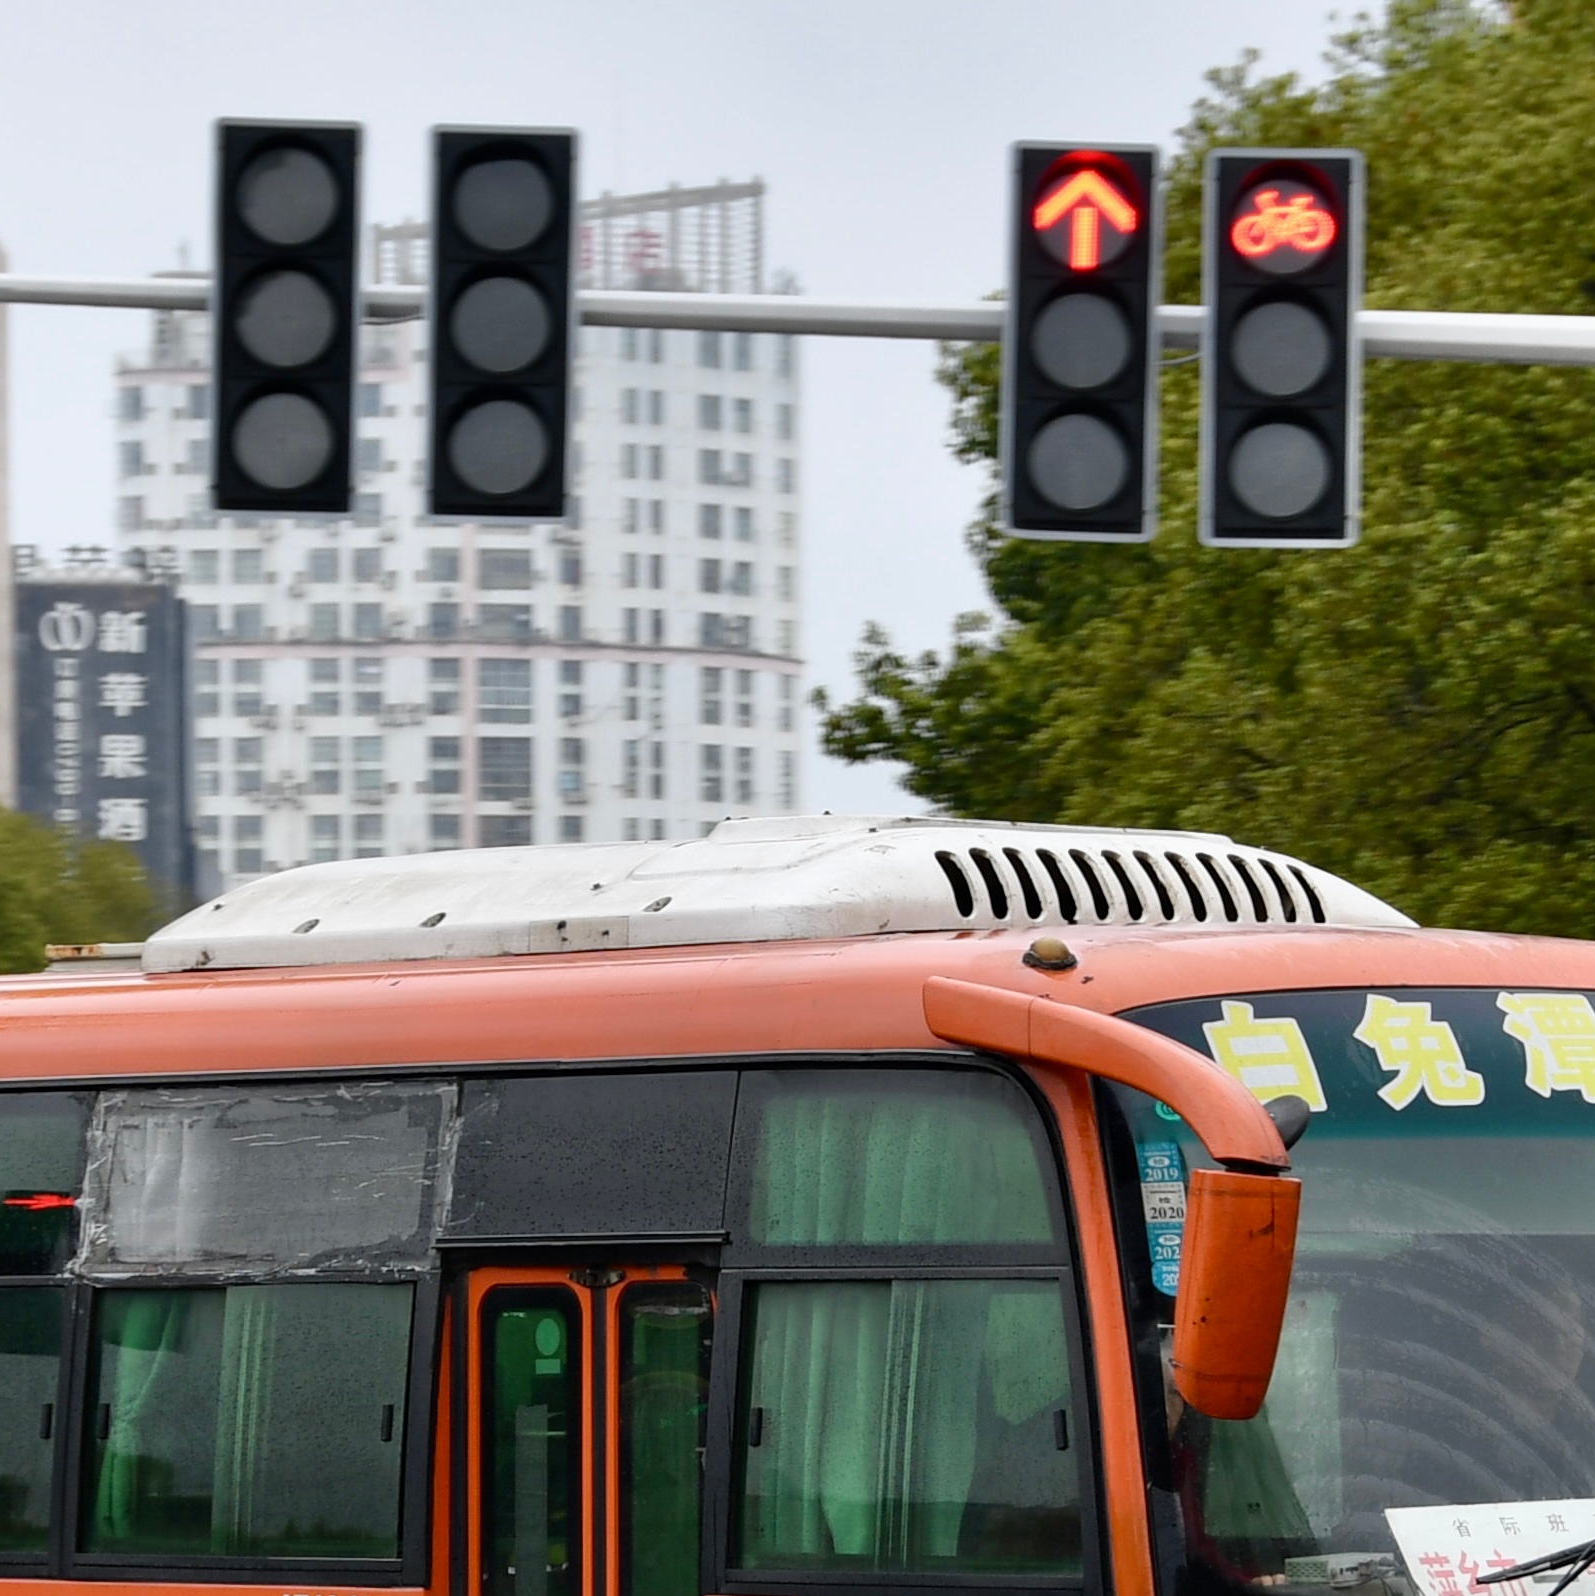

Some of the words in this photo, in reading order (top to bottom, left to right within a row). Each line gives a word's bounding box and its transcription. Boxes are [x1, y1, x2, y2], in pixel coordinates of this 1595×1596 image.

[97, 610, 149, 882] 新苹果酒
[1144, 1168, 1179, 1182] 2019
[1150, 1206, 1185, 1220] 2020
[1155, 1246, 1181, 1260] 202
